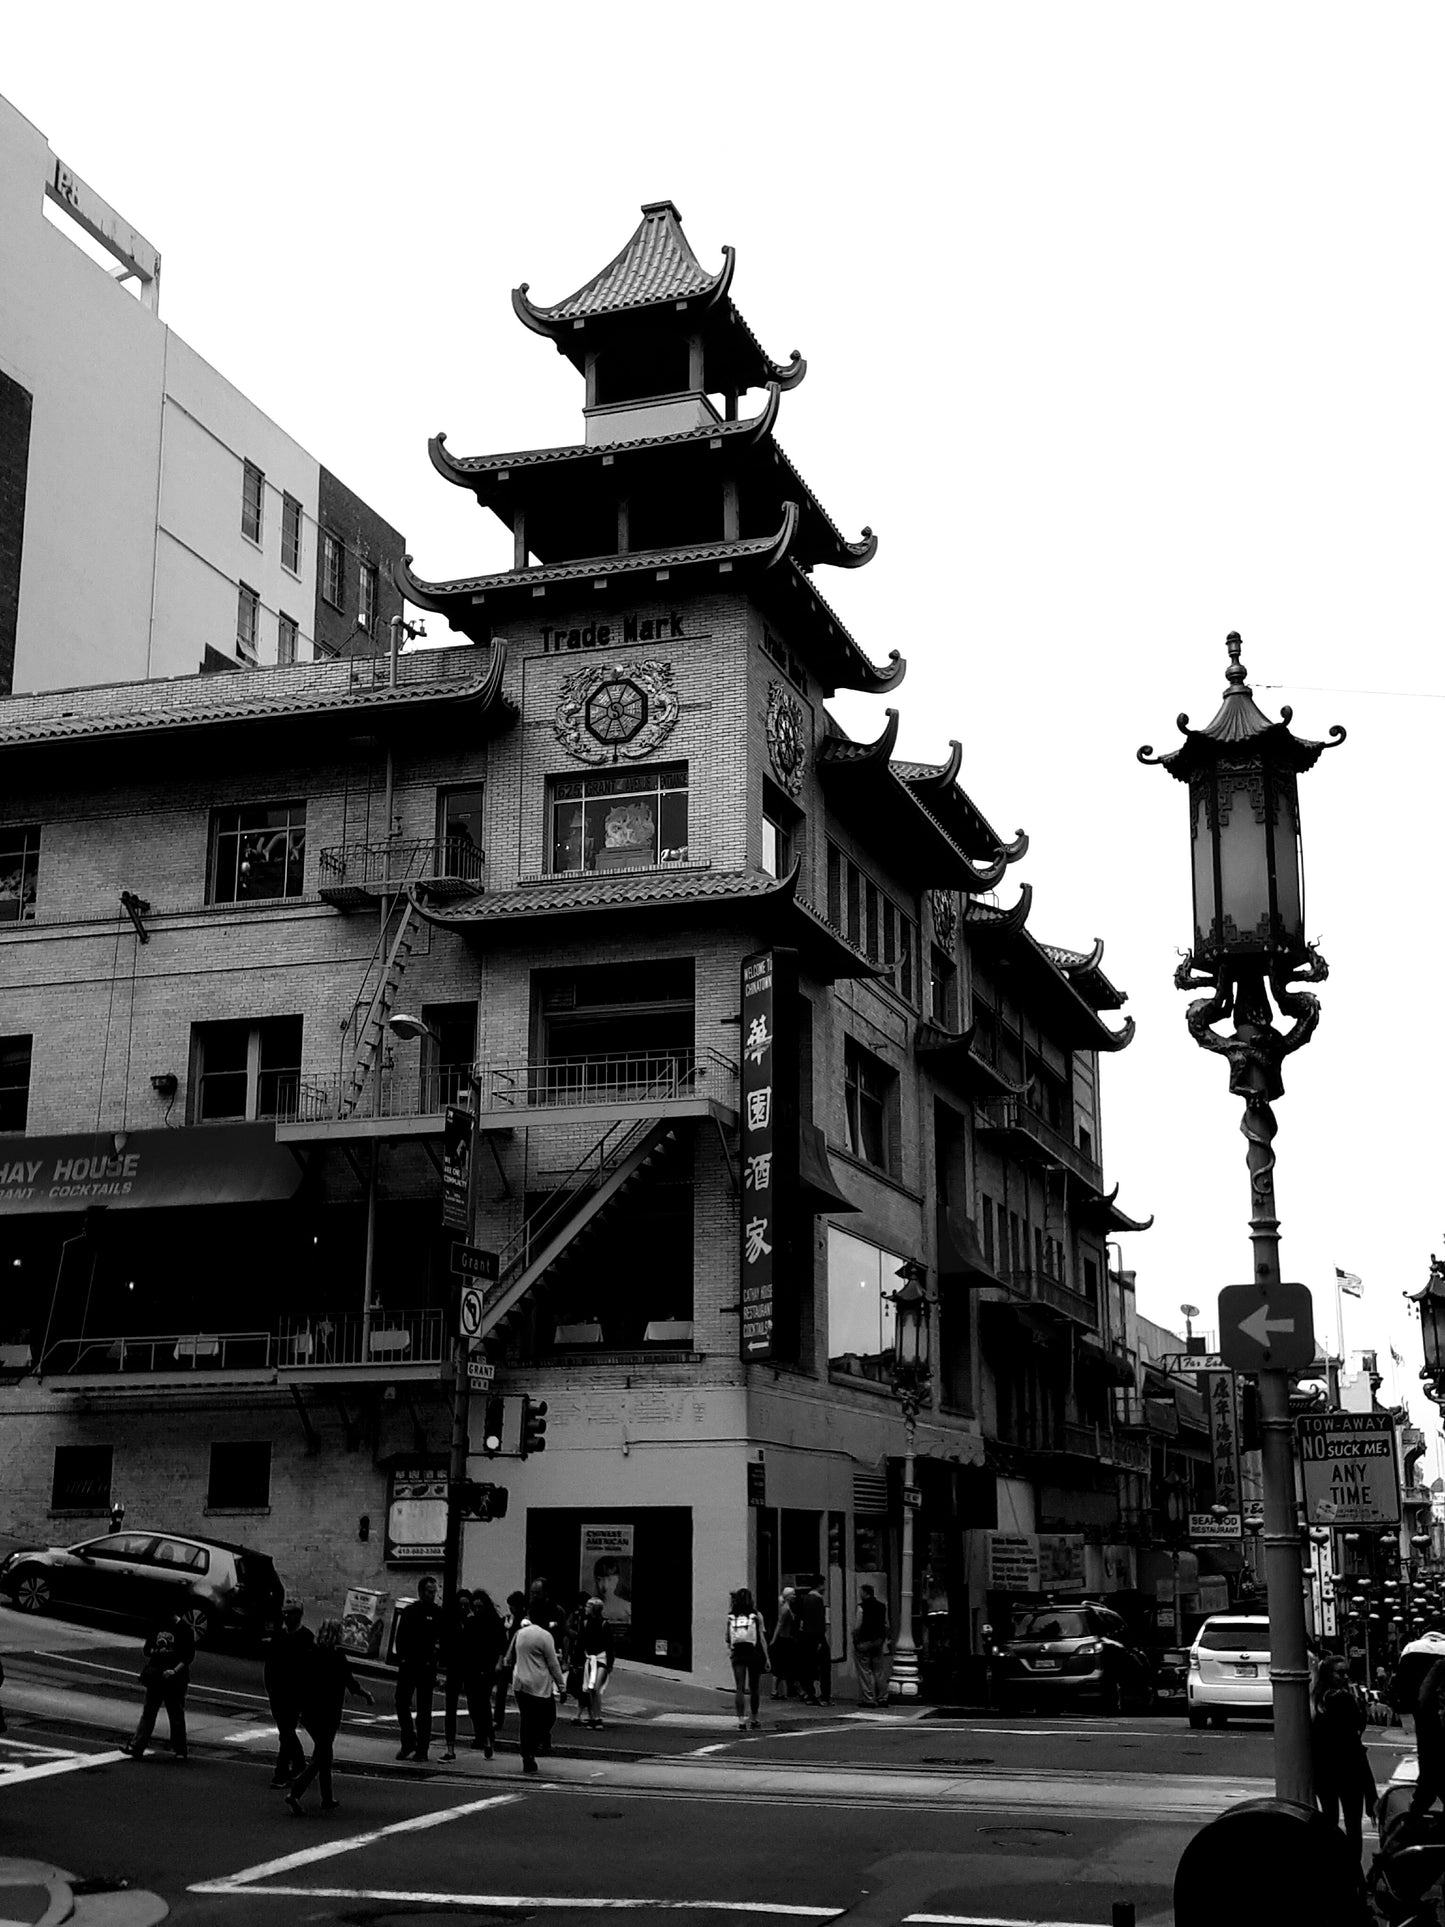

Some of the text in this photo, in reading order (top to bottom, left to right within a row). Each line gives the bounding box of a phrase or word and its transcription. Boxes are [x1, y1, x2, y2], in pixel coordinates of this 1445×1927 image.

[540, 611, 684, 652] Trade Mark
[557, 783, 580, 797] 625
[585, 780, 616, 794] GRANT
[744, 960, 766, 982] WELCOME
[745, 974, 772, 997] CHINATOWN
[744, 1014, 772, 1265] 華園酒家
[52, 1153, 141, 1181] HOUSE
[48, 1181, 133, 1198] COCKTAILS
[461, 1252, 490, 1273] Grant
[469, 1364, 493, 1377] GRANT
[1184, 1357, 1200, 1368] Far
[1304, 1416, 1386, 1432] TOW-AWAY
[1302, 1435, 1325, 1460] NO
[1327, 1443, 1361, 1457] SUCK
[1332, 1463, 1367, 1482] ANY
[1330, 1486, 1372, 1505] TIME
[585, 1538, 629, 1546] AMERICAN
[1323, 1571, 1333, 1632] Ameica
